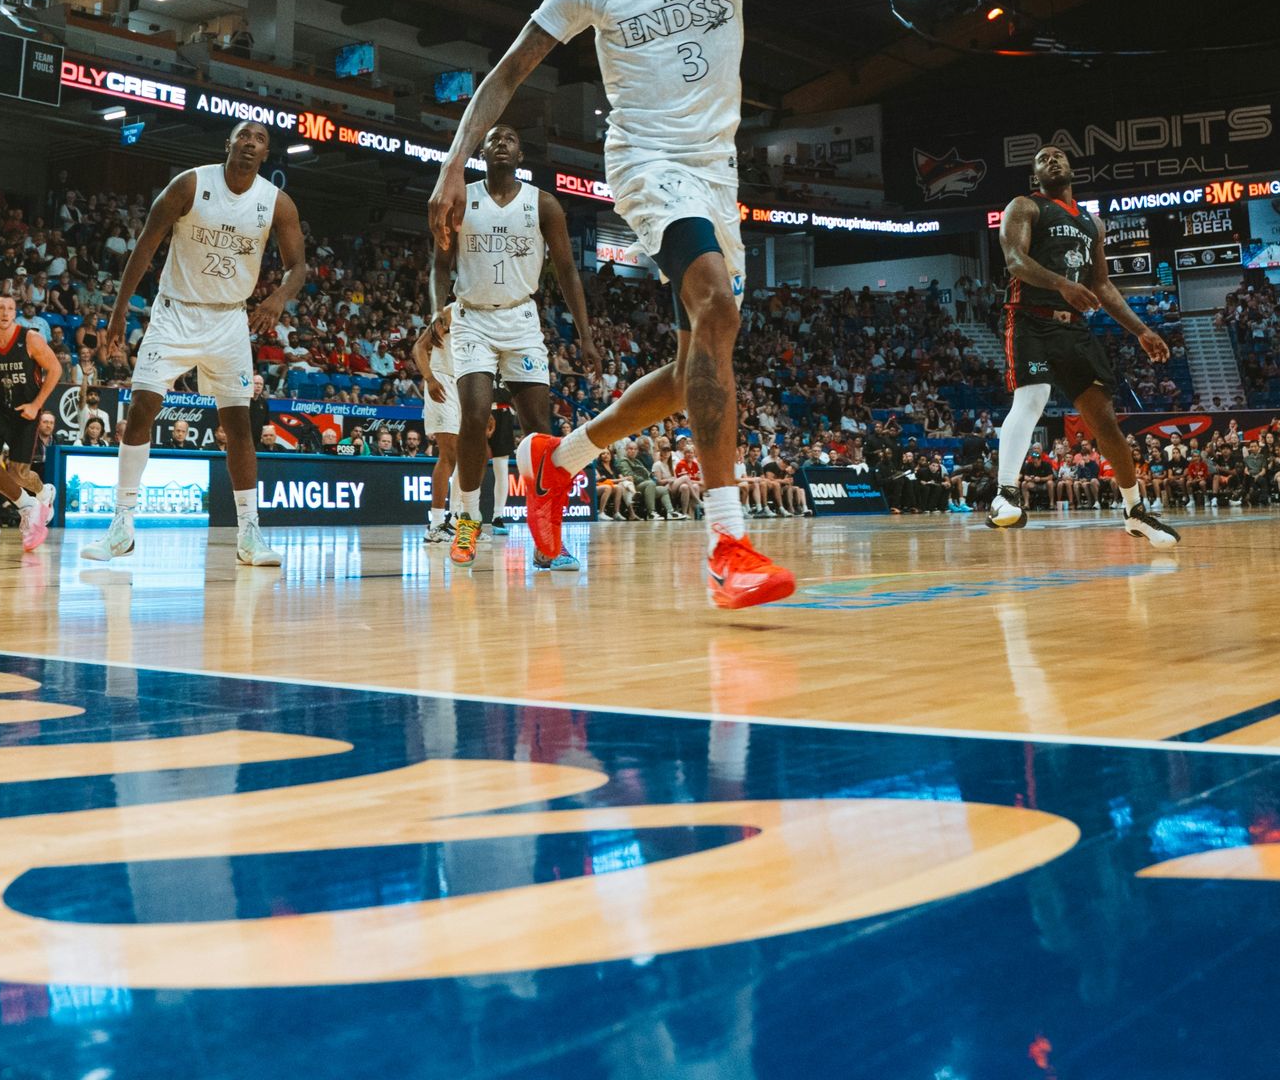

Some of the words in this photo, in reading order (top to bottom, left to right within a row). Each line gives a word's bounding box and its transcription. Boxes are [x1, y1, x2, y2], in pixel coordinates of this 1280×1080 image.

[34, 50, 54, 63] TEAM
[677, 40, 710, 84] 3
[32, 60, 54, 74] FOULS
[197, 93, 210, 112] A
[210, 96, 275, 127] DIVISION
[276, 111, 297, 130] OF
[339, 127, 401, 154] BMGROUP
[1109, 199, 1121, 213] A
[1120, 192, 1181, 210] DIVISION
[1183, 188, 1203, 204] OF
[752, 208, 809, 225] BMGROUP
[1191, 208, 1232, 223] CRAFT
[220, 223, 236, 234] THE
[492, 225, 509, 235] THE
[1192, 218, 1233, 235] BEER
[201, 252, 237, 281] 23
[493, 259, 505, 285] 1
[8, 361, 24, 371] FOX
[11, 372, 27, 385] 55
[155, 406, 204, 423] Michelob
[290, 400, 322, 414] Langley
[324, 403, 352, 416] Events
[351, 405, 379, 417] Centre
[336, 444, 356, 456] POSS
[257, 479, 365, 509] LANGLEY
[808, 482, 849, 499] RONA
